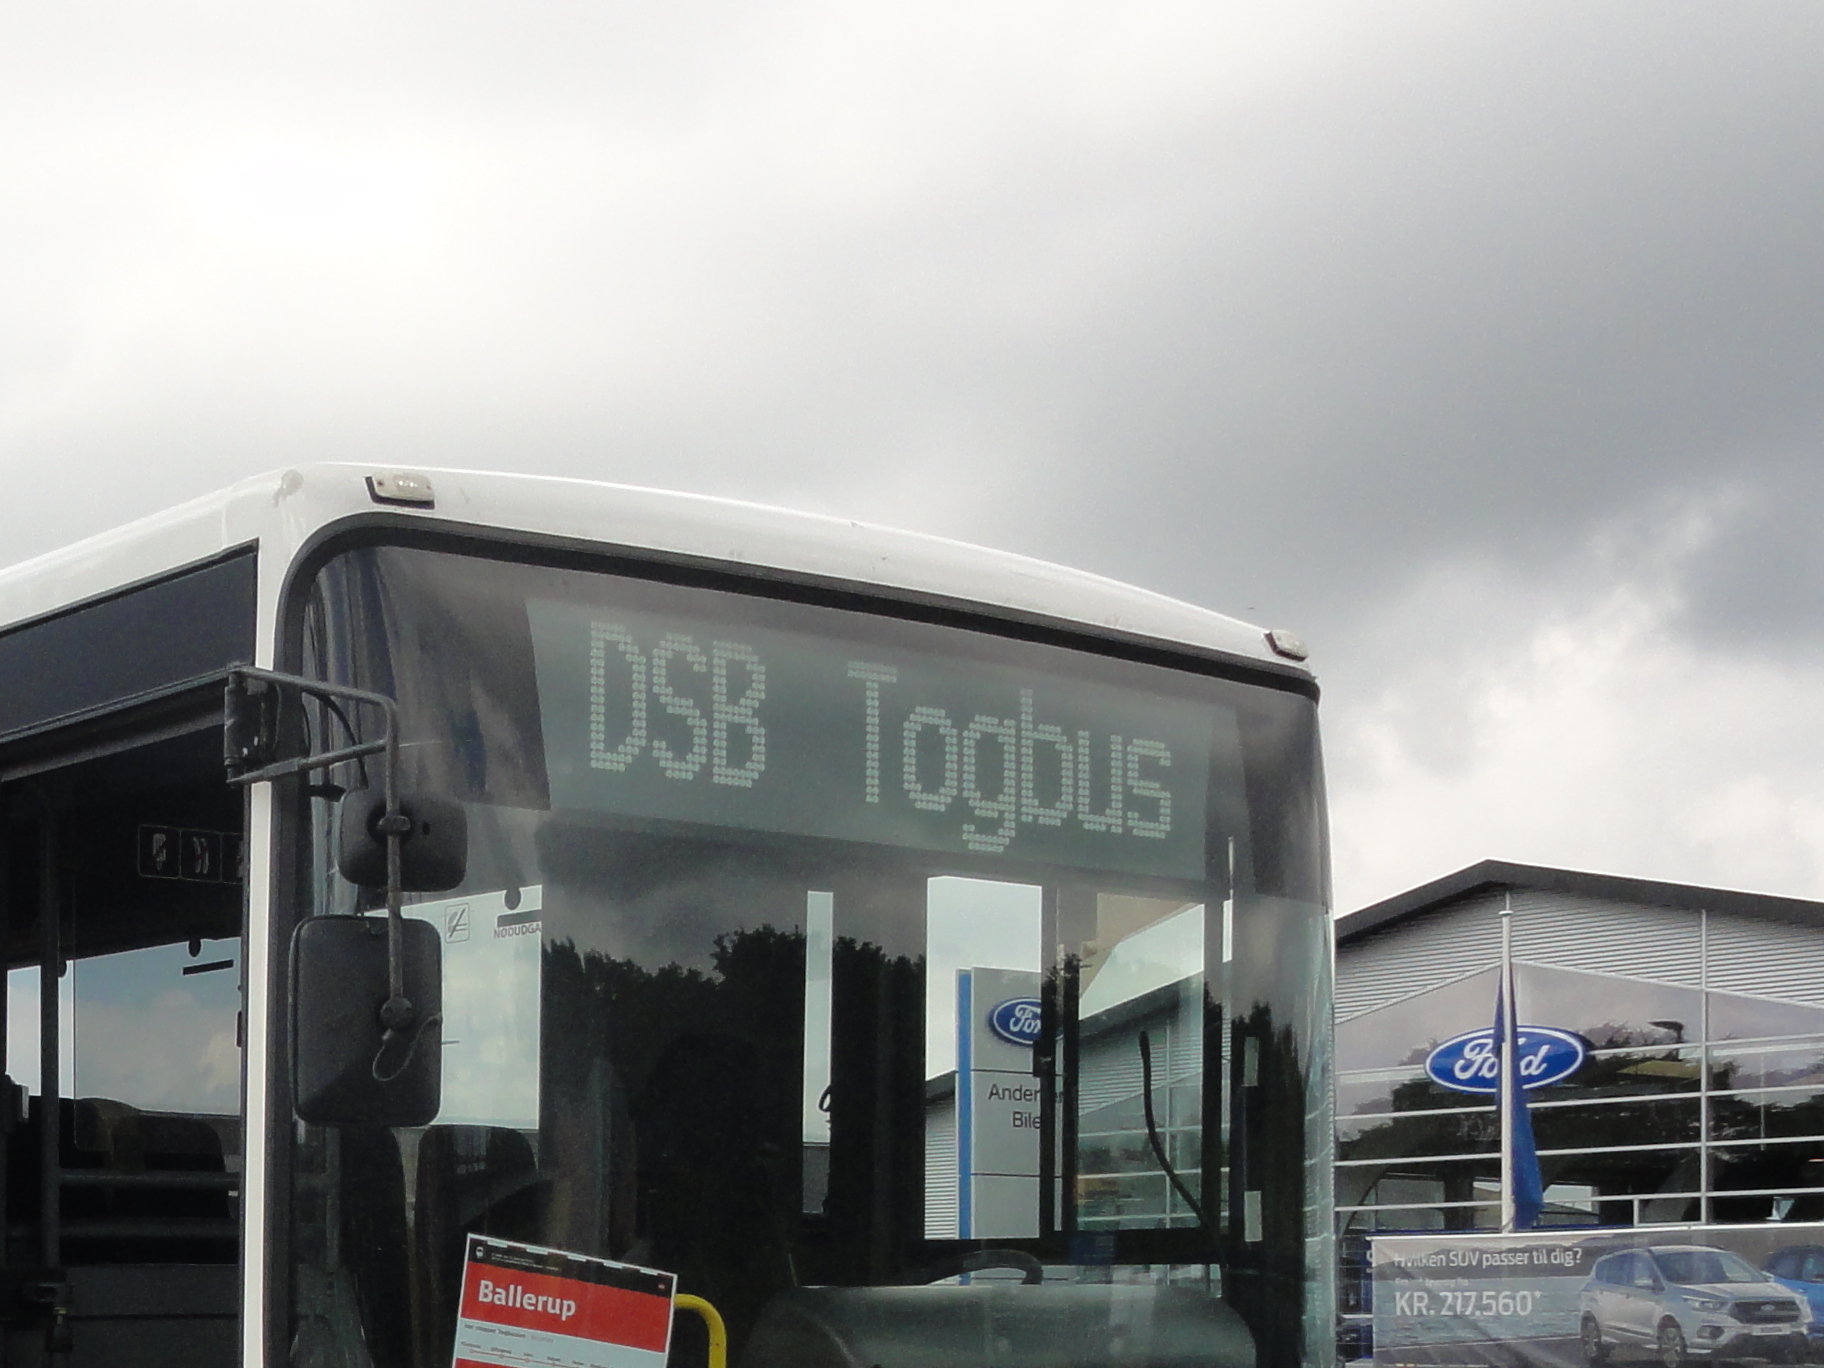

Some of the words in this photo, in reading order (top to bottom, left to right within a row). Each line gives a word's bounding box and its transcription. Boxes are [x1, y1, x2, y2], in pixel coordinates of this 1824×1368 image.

[589, 621, 766, 789] DSB
[847, 660, 1172, 853] Togbus
[493, 923, 542, 939] NØDUDGA
[1453, 1037, 1551, 1080] Fod
[988, 1083, 1063, 1103] Ander
[1012, 1110, 1042, 1130] Bile
[1394, 1251, 1446, 1267] Hvilken
[1449, 1251, 1479, 1267] SUV
[1482, 1252, 1529, 1269] passer
[1532, 1249, 1547, 1265] til
[1551, 1248, 1583, 1267] dig?
[478, 1279, 577, 1321] Ballerup
[1394, 1291, 1435, 1316] KR.
